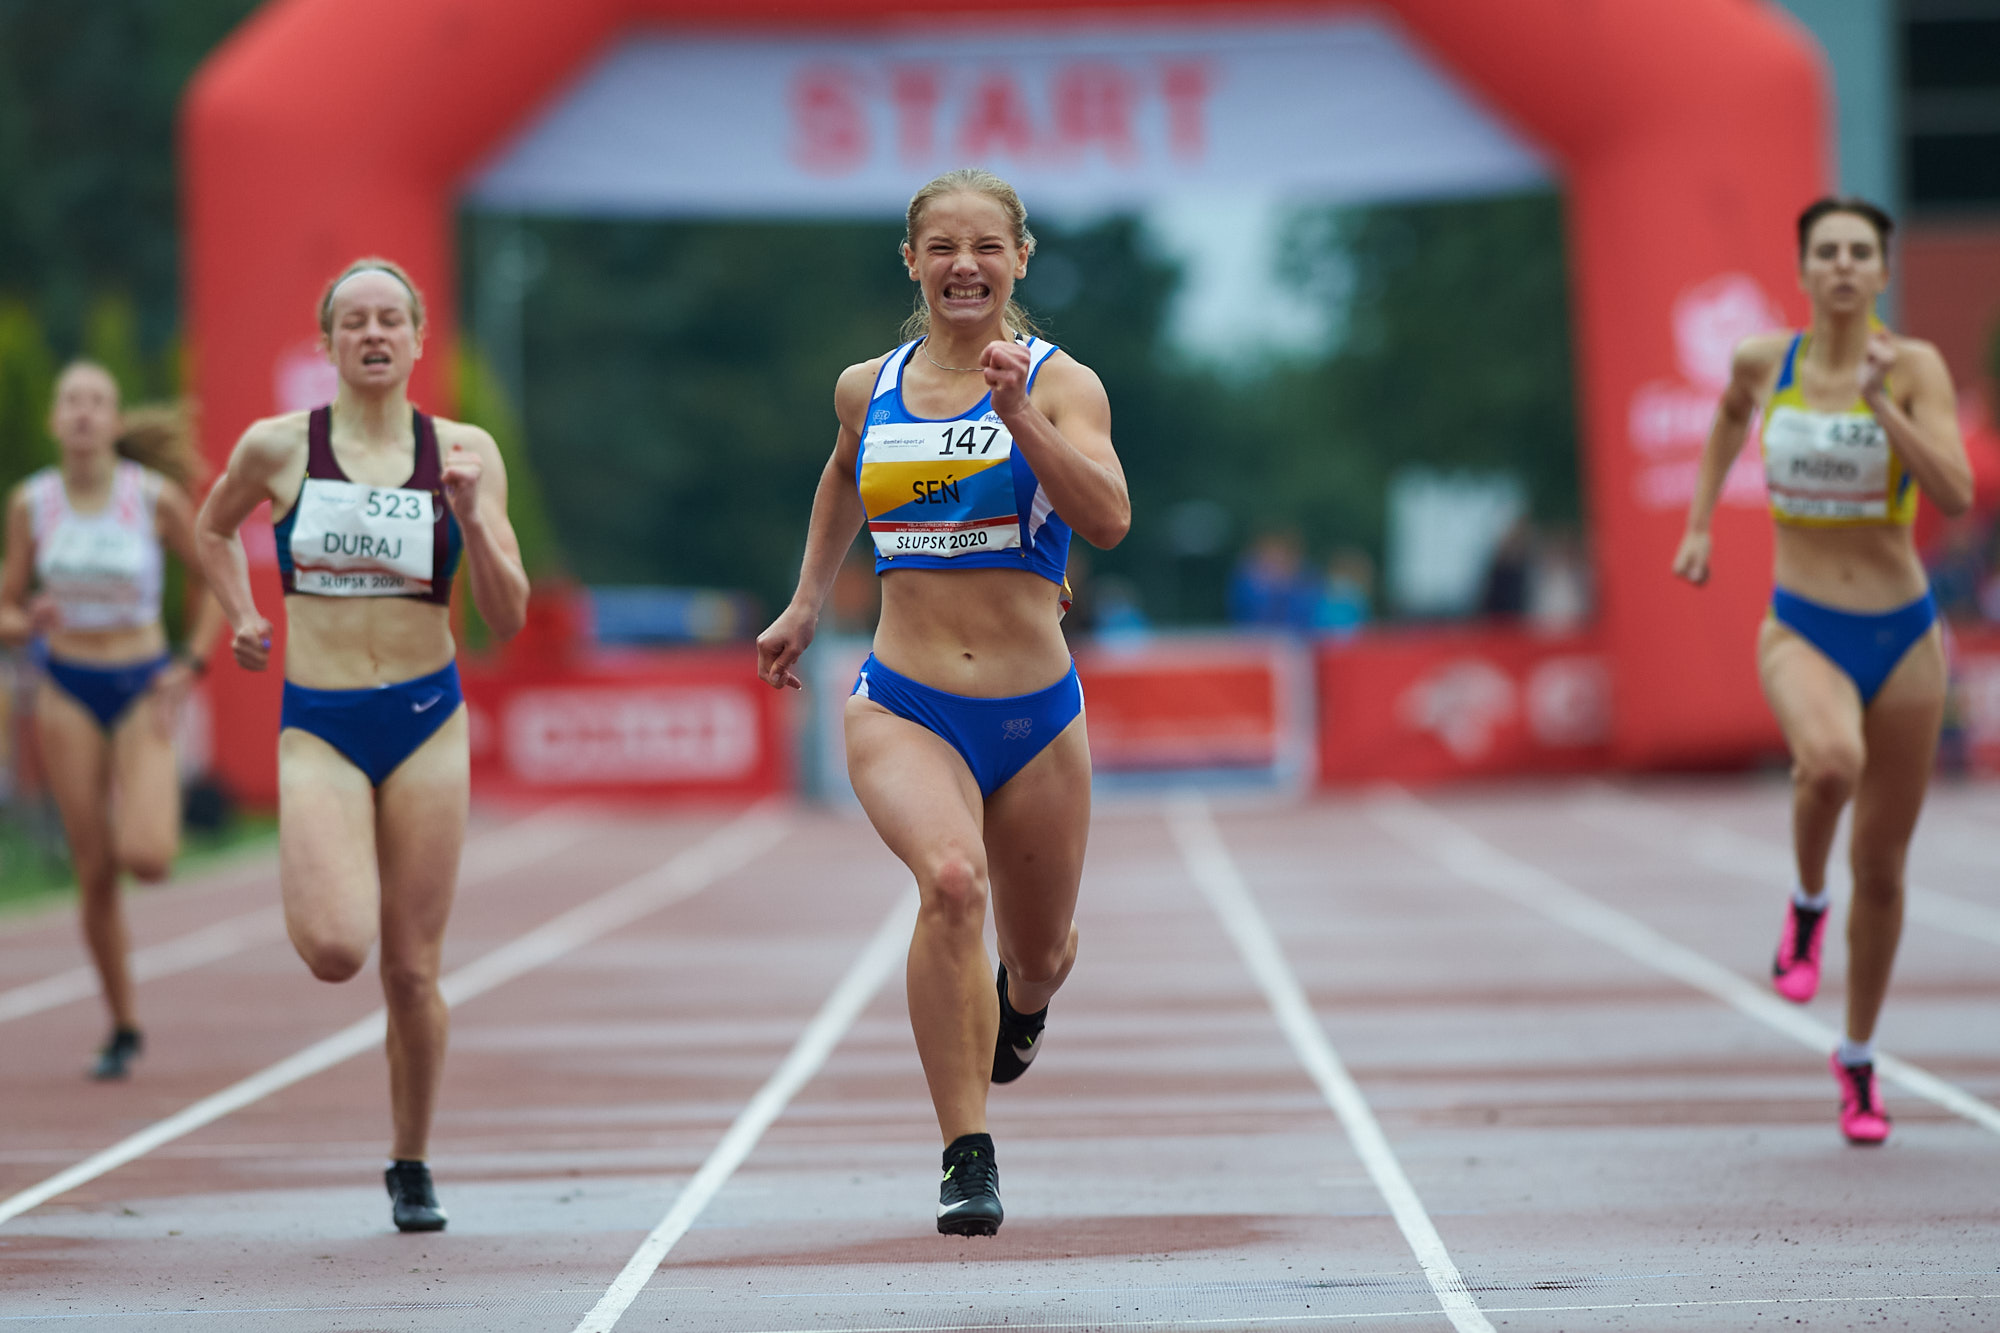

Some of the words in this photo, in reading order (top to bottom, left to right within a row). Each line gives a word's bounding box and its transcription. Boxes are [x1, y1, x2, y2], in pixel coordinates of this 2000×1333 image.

[788, 53, 1219, 177] START
[939, 426, 1000, 455] 147
[912, 474, 960, 504] SEŃ
[366, 491, 422, 520] 523
[323, 532, 403, 559] DURAJ
[896, 535, 947, 549] SŁUPSK
[949, 531, 988, 549] 2020
[371, 575, 406, 588] 2020
